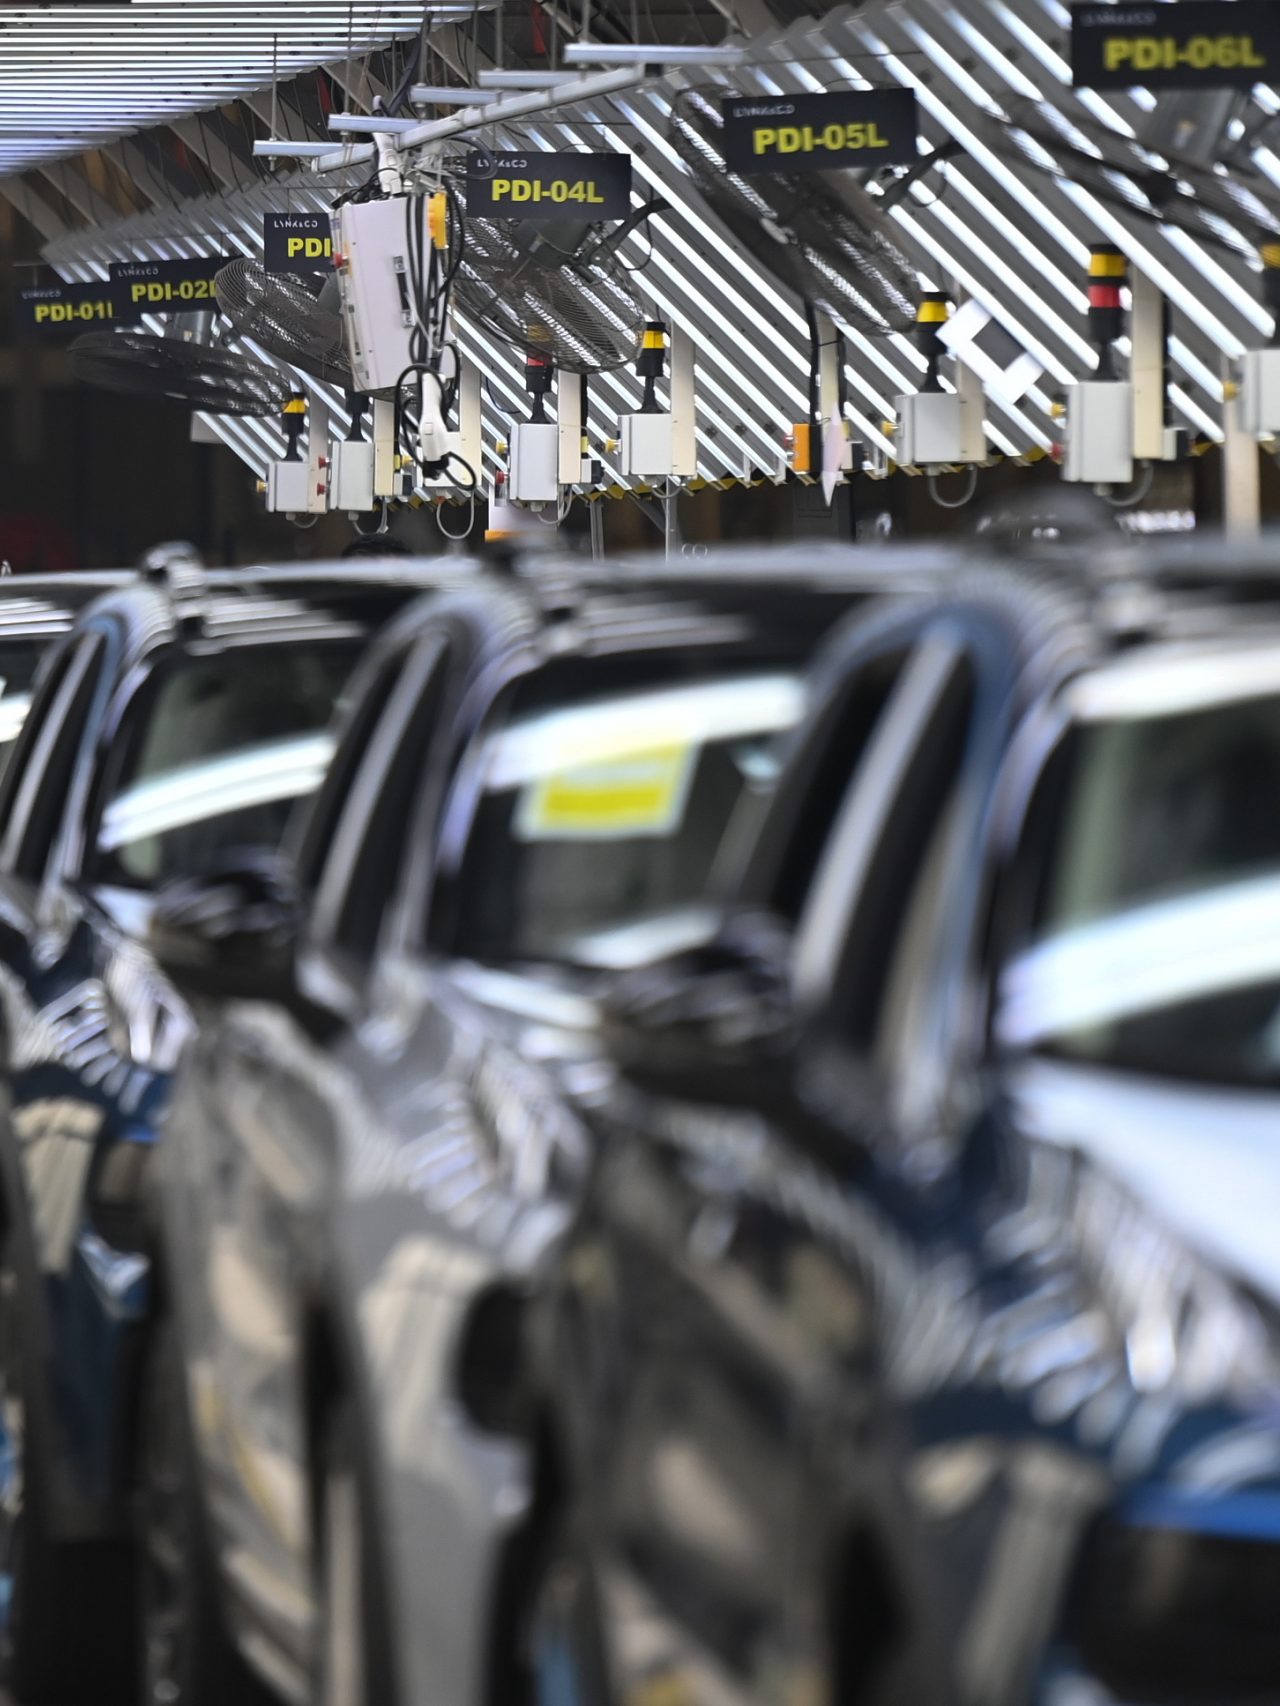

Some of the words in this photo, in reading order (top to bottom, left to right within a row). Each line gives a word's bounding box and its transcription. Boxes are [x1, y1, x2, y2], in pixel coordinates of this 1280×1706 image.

[1104, 36, 1265, 70] PDI-06L
[753, 123, 888, 155] PDI-05L
[491, 178, 604, 204] PDI-04L
[287, 237, 332, 258] PDI
